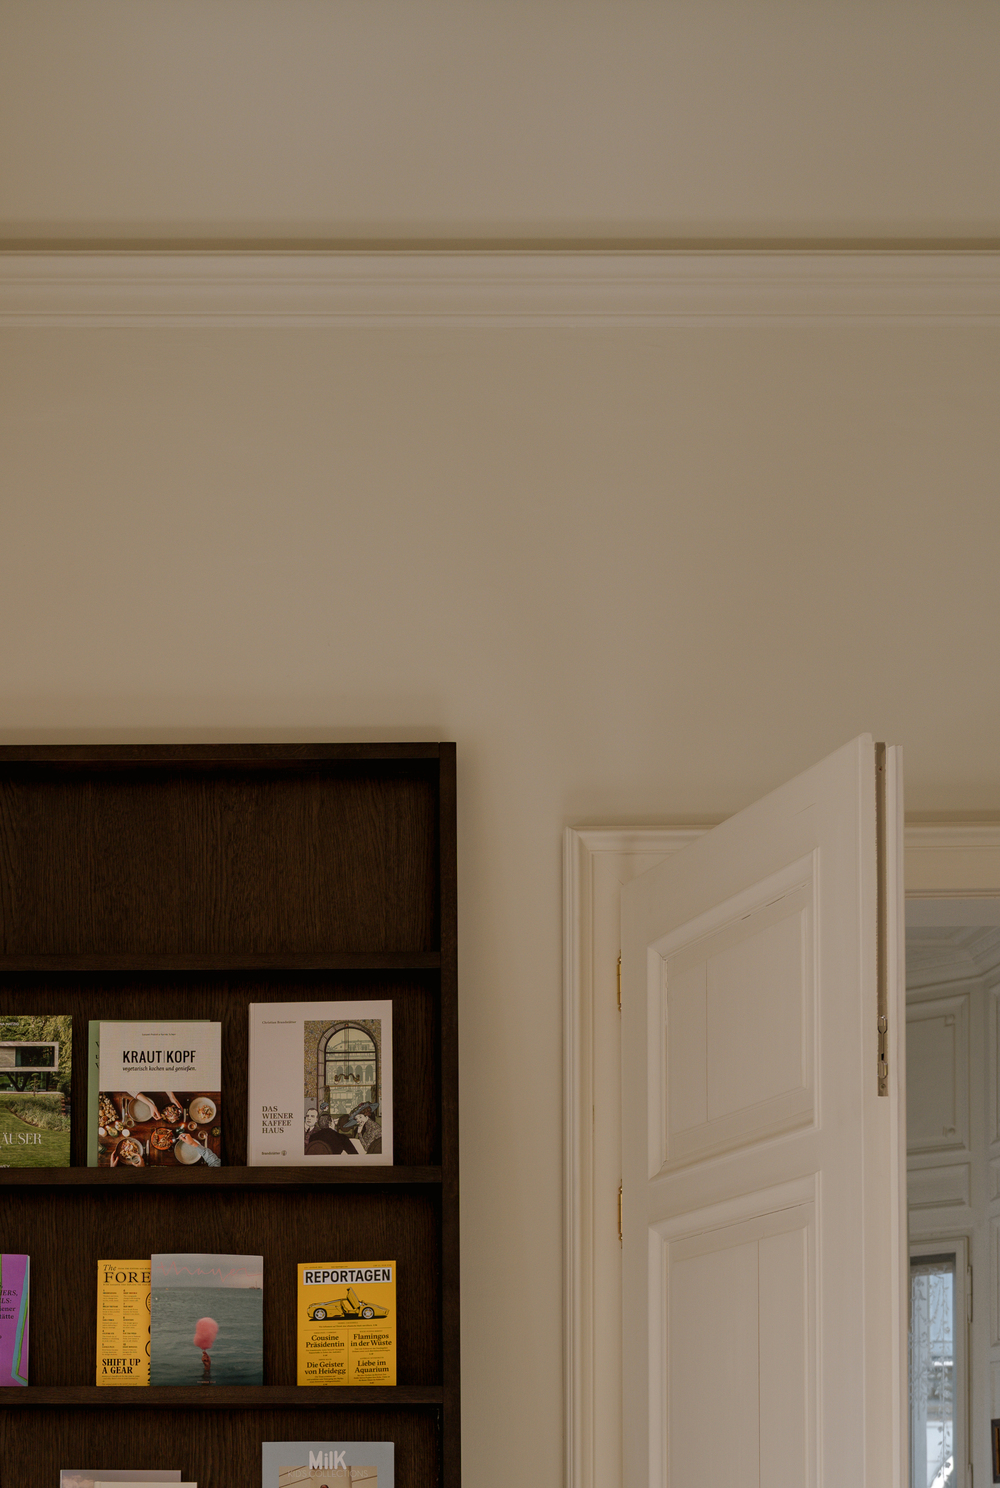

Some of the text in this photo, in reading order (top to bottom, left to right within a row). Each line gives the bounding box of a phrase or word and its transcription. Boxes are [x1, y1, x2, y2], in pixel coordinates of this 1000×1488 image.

[122, 1050, 196, 1063] KRAUT KOPF
[104, 1272, 151, 1283] FORE
[305, 1269, 390, 1284] REPORTAGEN
[309, 1450, 347, 1470] MilK
